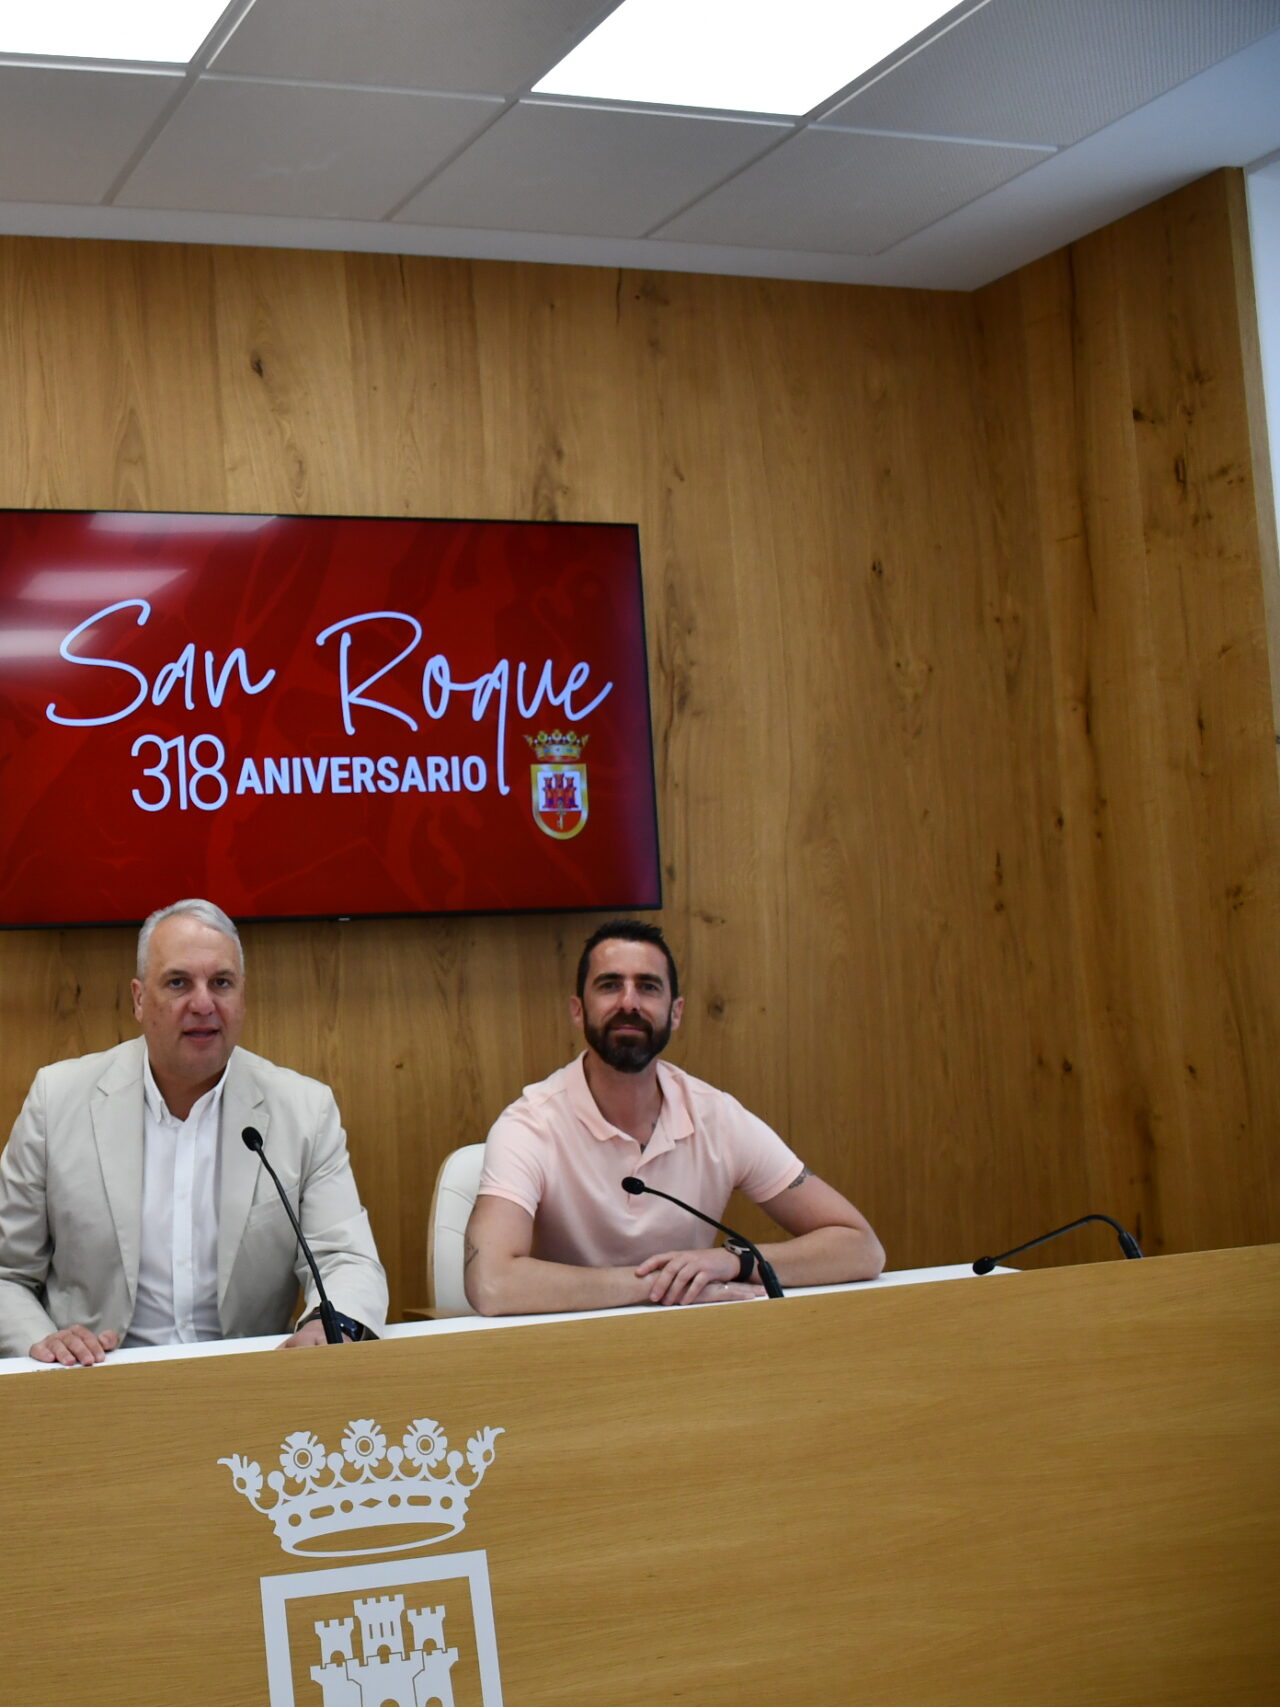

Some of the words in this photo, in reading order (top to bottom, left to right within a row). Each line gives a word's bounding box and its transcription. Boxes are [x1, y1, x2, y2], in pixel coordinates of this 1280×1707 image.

[46, 598, 276, 727] San
[316, 610, 614, 796] Roque
[130, 733, 229, 812] 318
[235, 755, 488, 796] ANIVERSARIO
